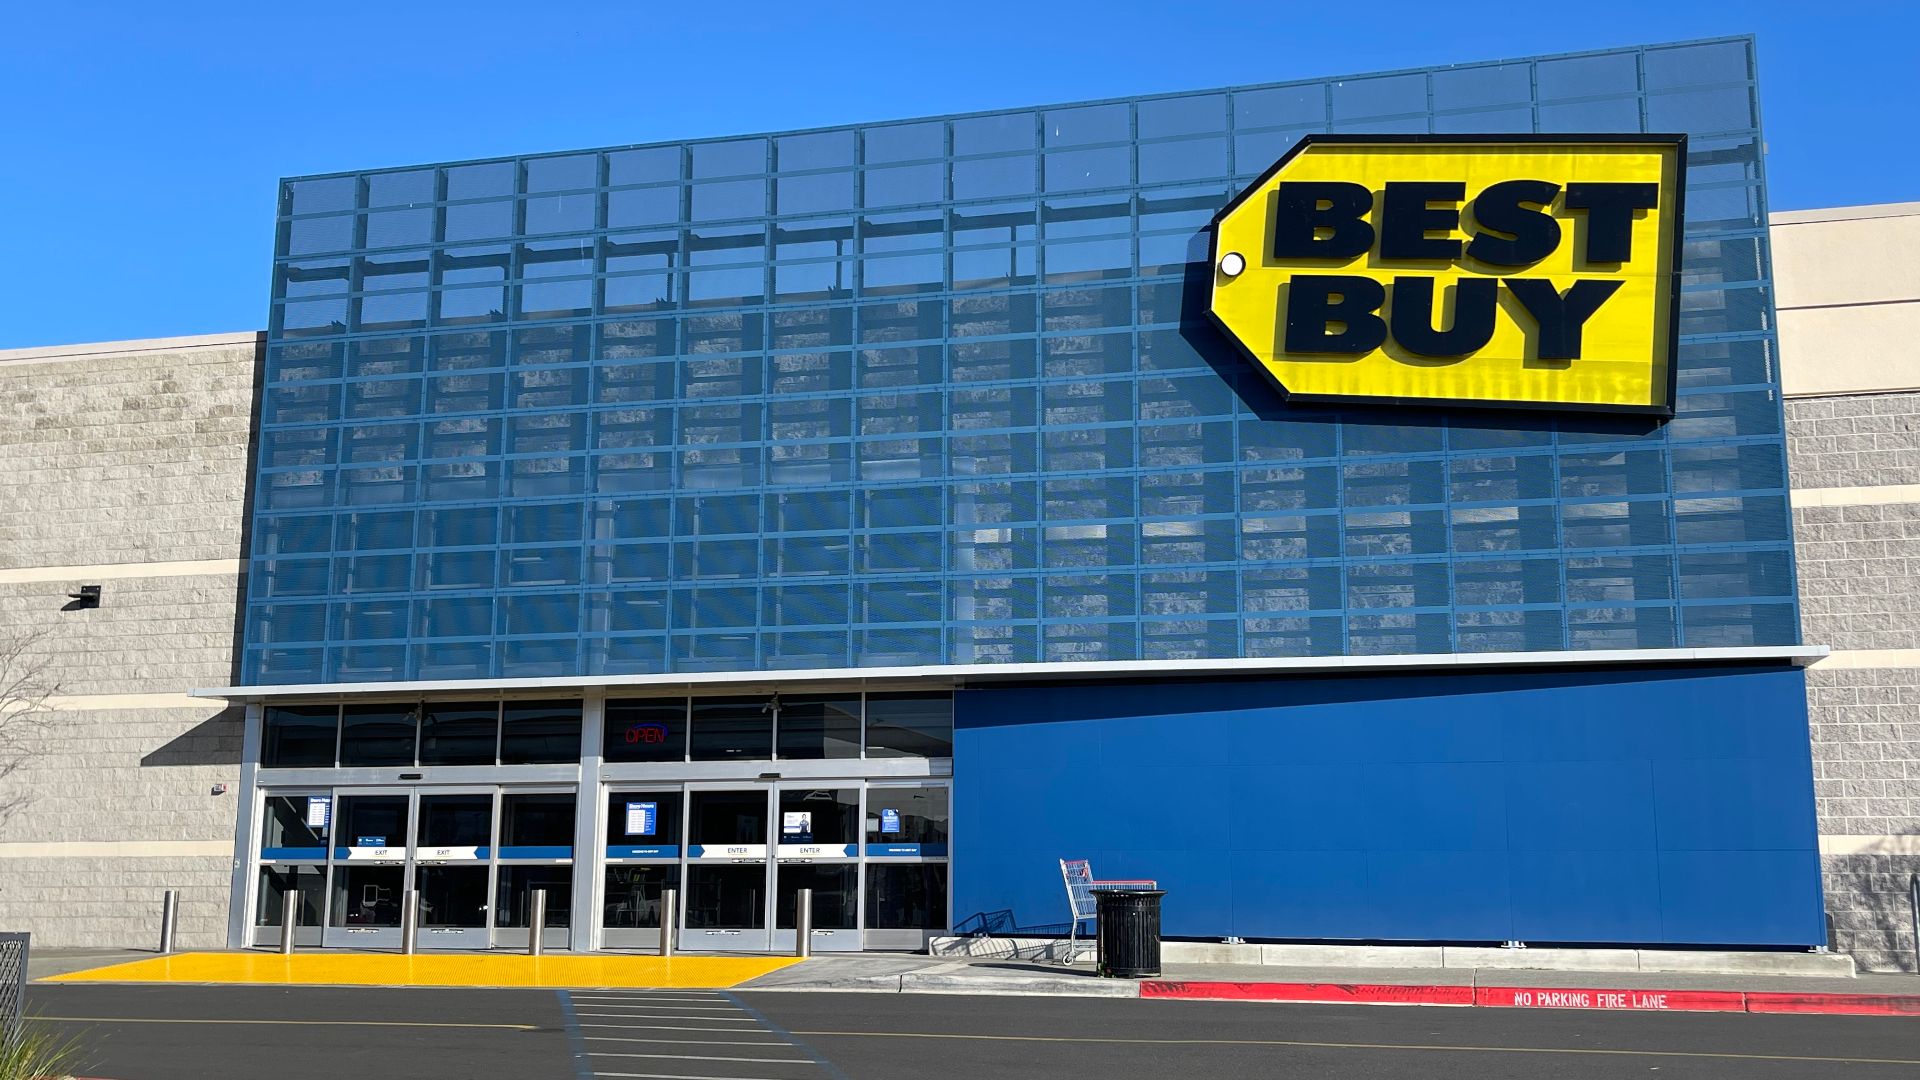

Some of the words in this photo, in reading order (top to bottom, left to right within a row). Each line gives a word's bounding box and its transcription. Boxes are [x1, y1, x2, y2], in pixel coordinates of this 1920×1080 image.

[1274, 180, 1659, 266] BEST
[1285, 275, 1626, 360] BUY
[625, 727, 665, 744] OPEN
[1514, 992, 1532, 1006] NO
[1537, 992, 1590, 1007] PARKING
[1597, 993, 1627, 1008] FIRE
[1632, 994, 1668, 1009] LANE
